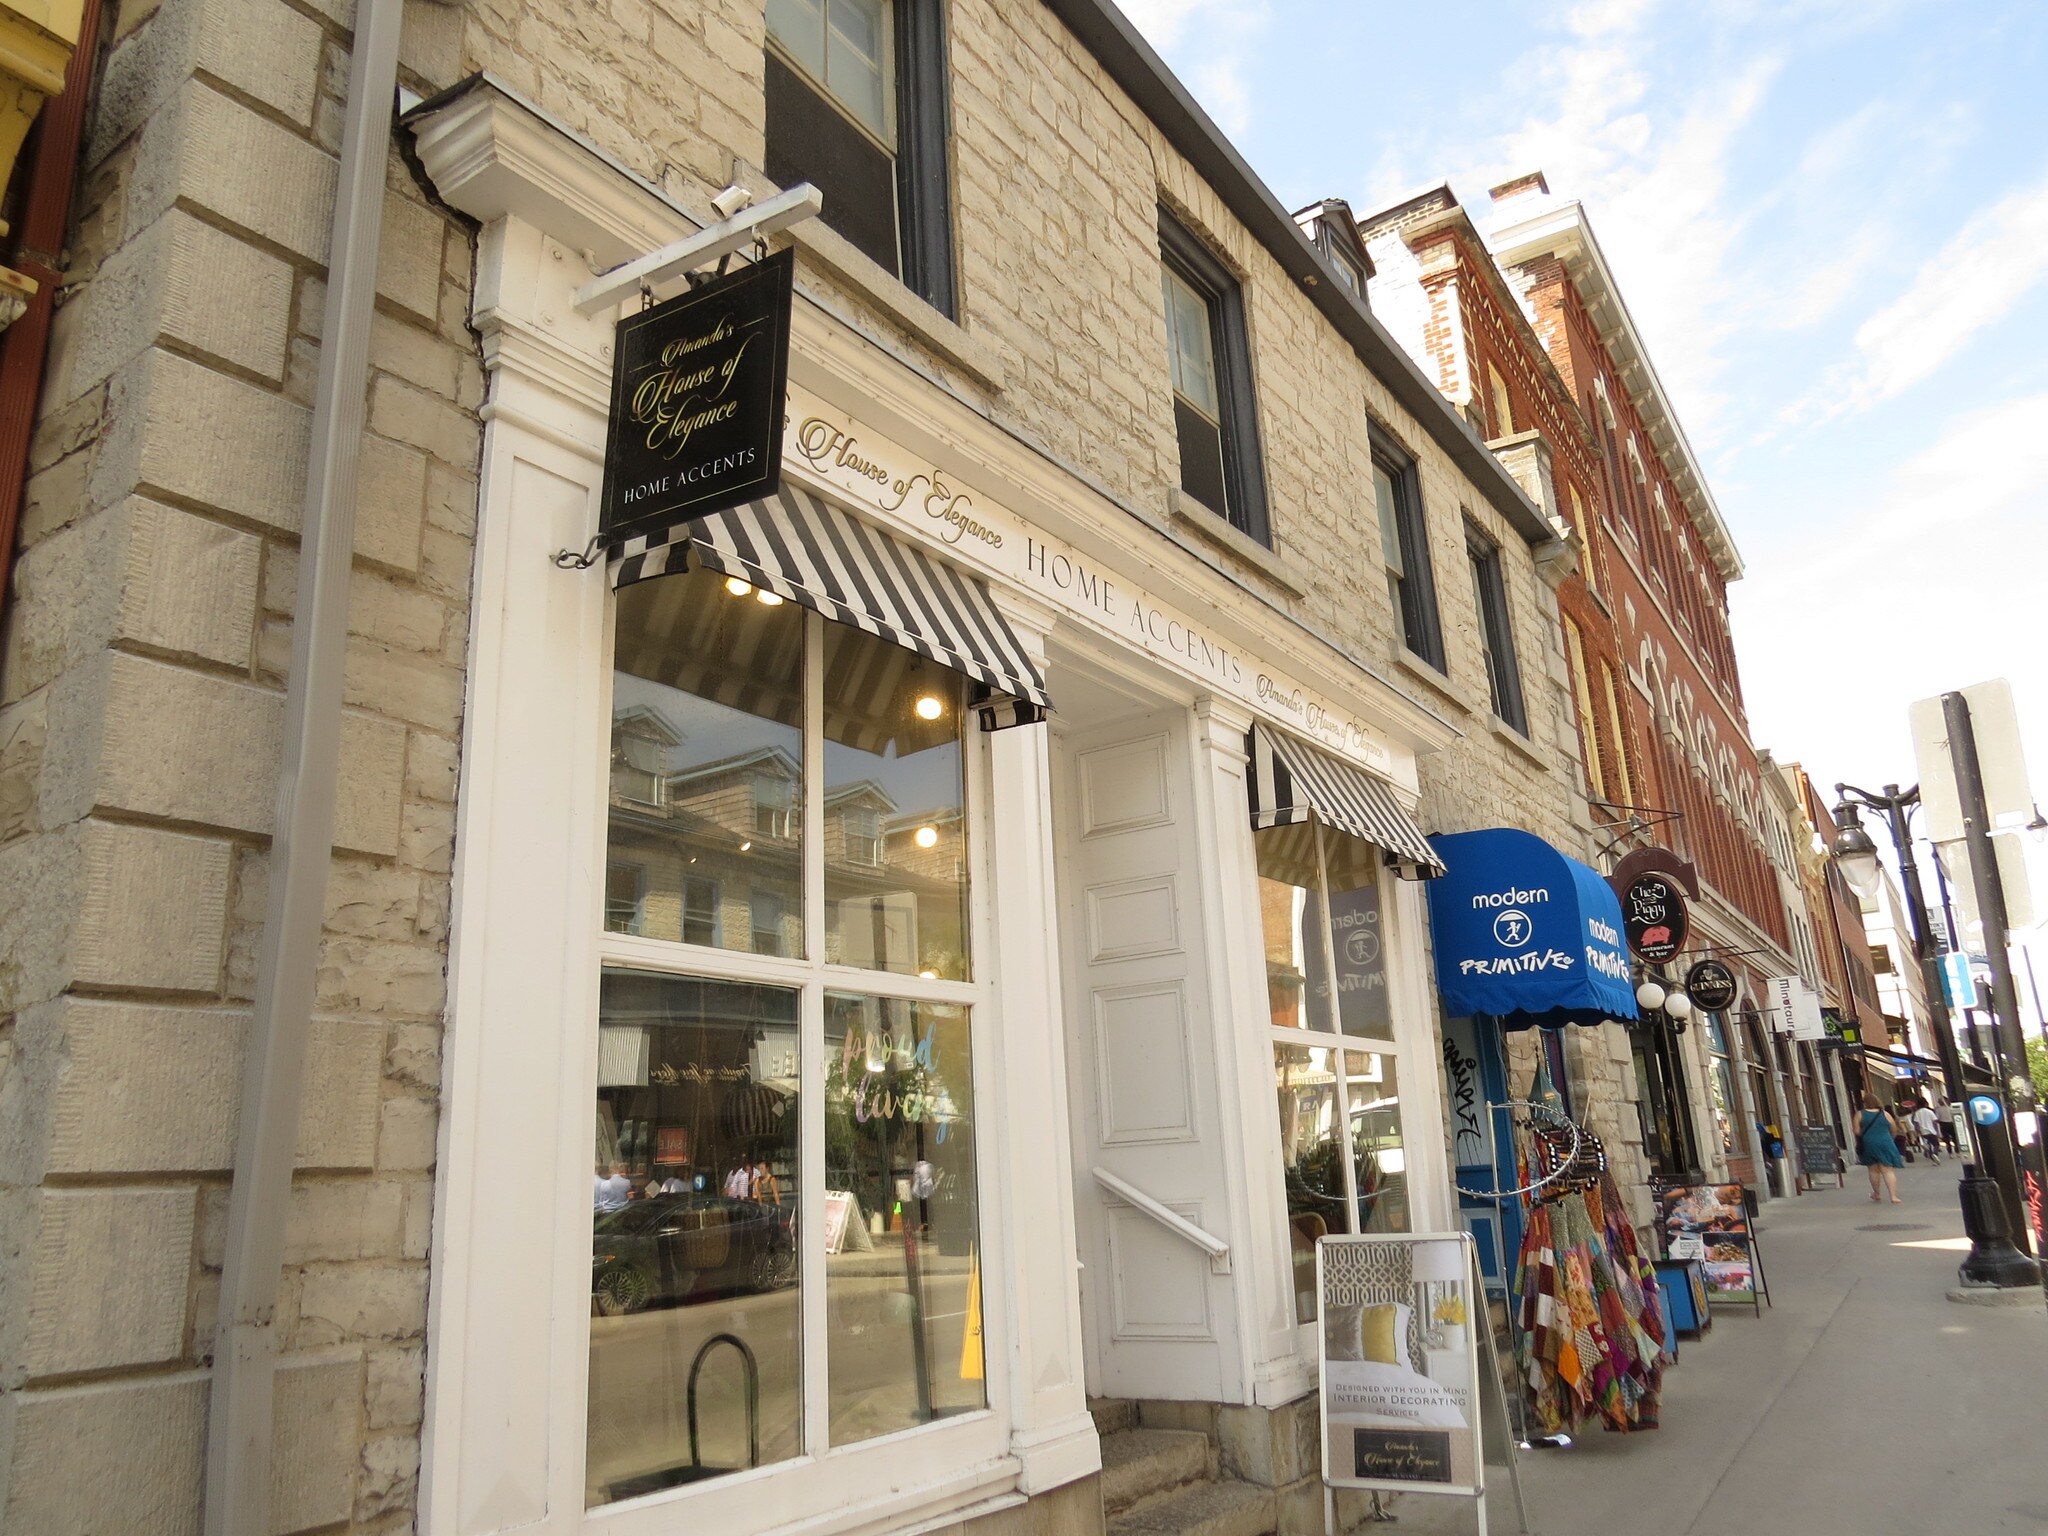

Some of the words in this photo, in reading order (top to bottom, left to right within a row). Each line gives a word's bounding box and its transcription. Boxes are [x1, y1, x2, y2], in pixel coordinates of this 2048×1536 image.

[660, 313, 734, 367] Amanda's
[631, 366, 715, 424] House
[704, 332, 763, 402] of
[646, 394, 737, 461] Elegance
[624, 477, 670, 504] HOME
[677, 448, 755, 487] ACCENTS
[796, 416, 889, 485] House
[879, 474, 930, 511] of
[924, 469, 1003, 549] Elegance
[1027, 537, 1116, 616] HOME
[1130, 600, 1242, 684] ACCENTS
[1256, 673, 1303, 716] Amanda's
[1472, 887, 1549, 909] modern
[1631, 900, 1666, 925] Piggy
[1589, 917, 1620, 948] modern
[1640, 943, 1675, 952] restaurant
[1690, 980, 1733, 992] GUINNESS
[1974, 1101, 1994, 1121] P
[1333, 1393, 1387, 1404] INTERIOR
[1391, 1394, 1466, 1407] DECORATING
[1376, 1407, 1420, 1417] SERVICES
